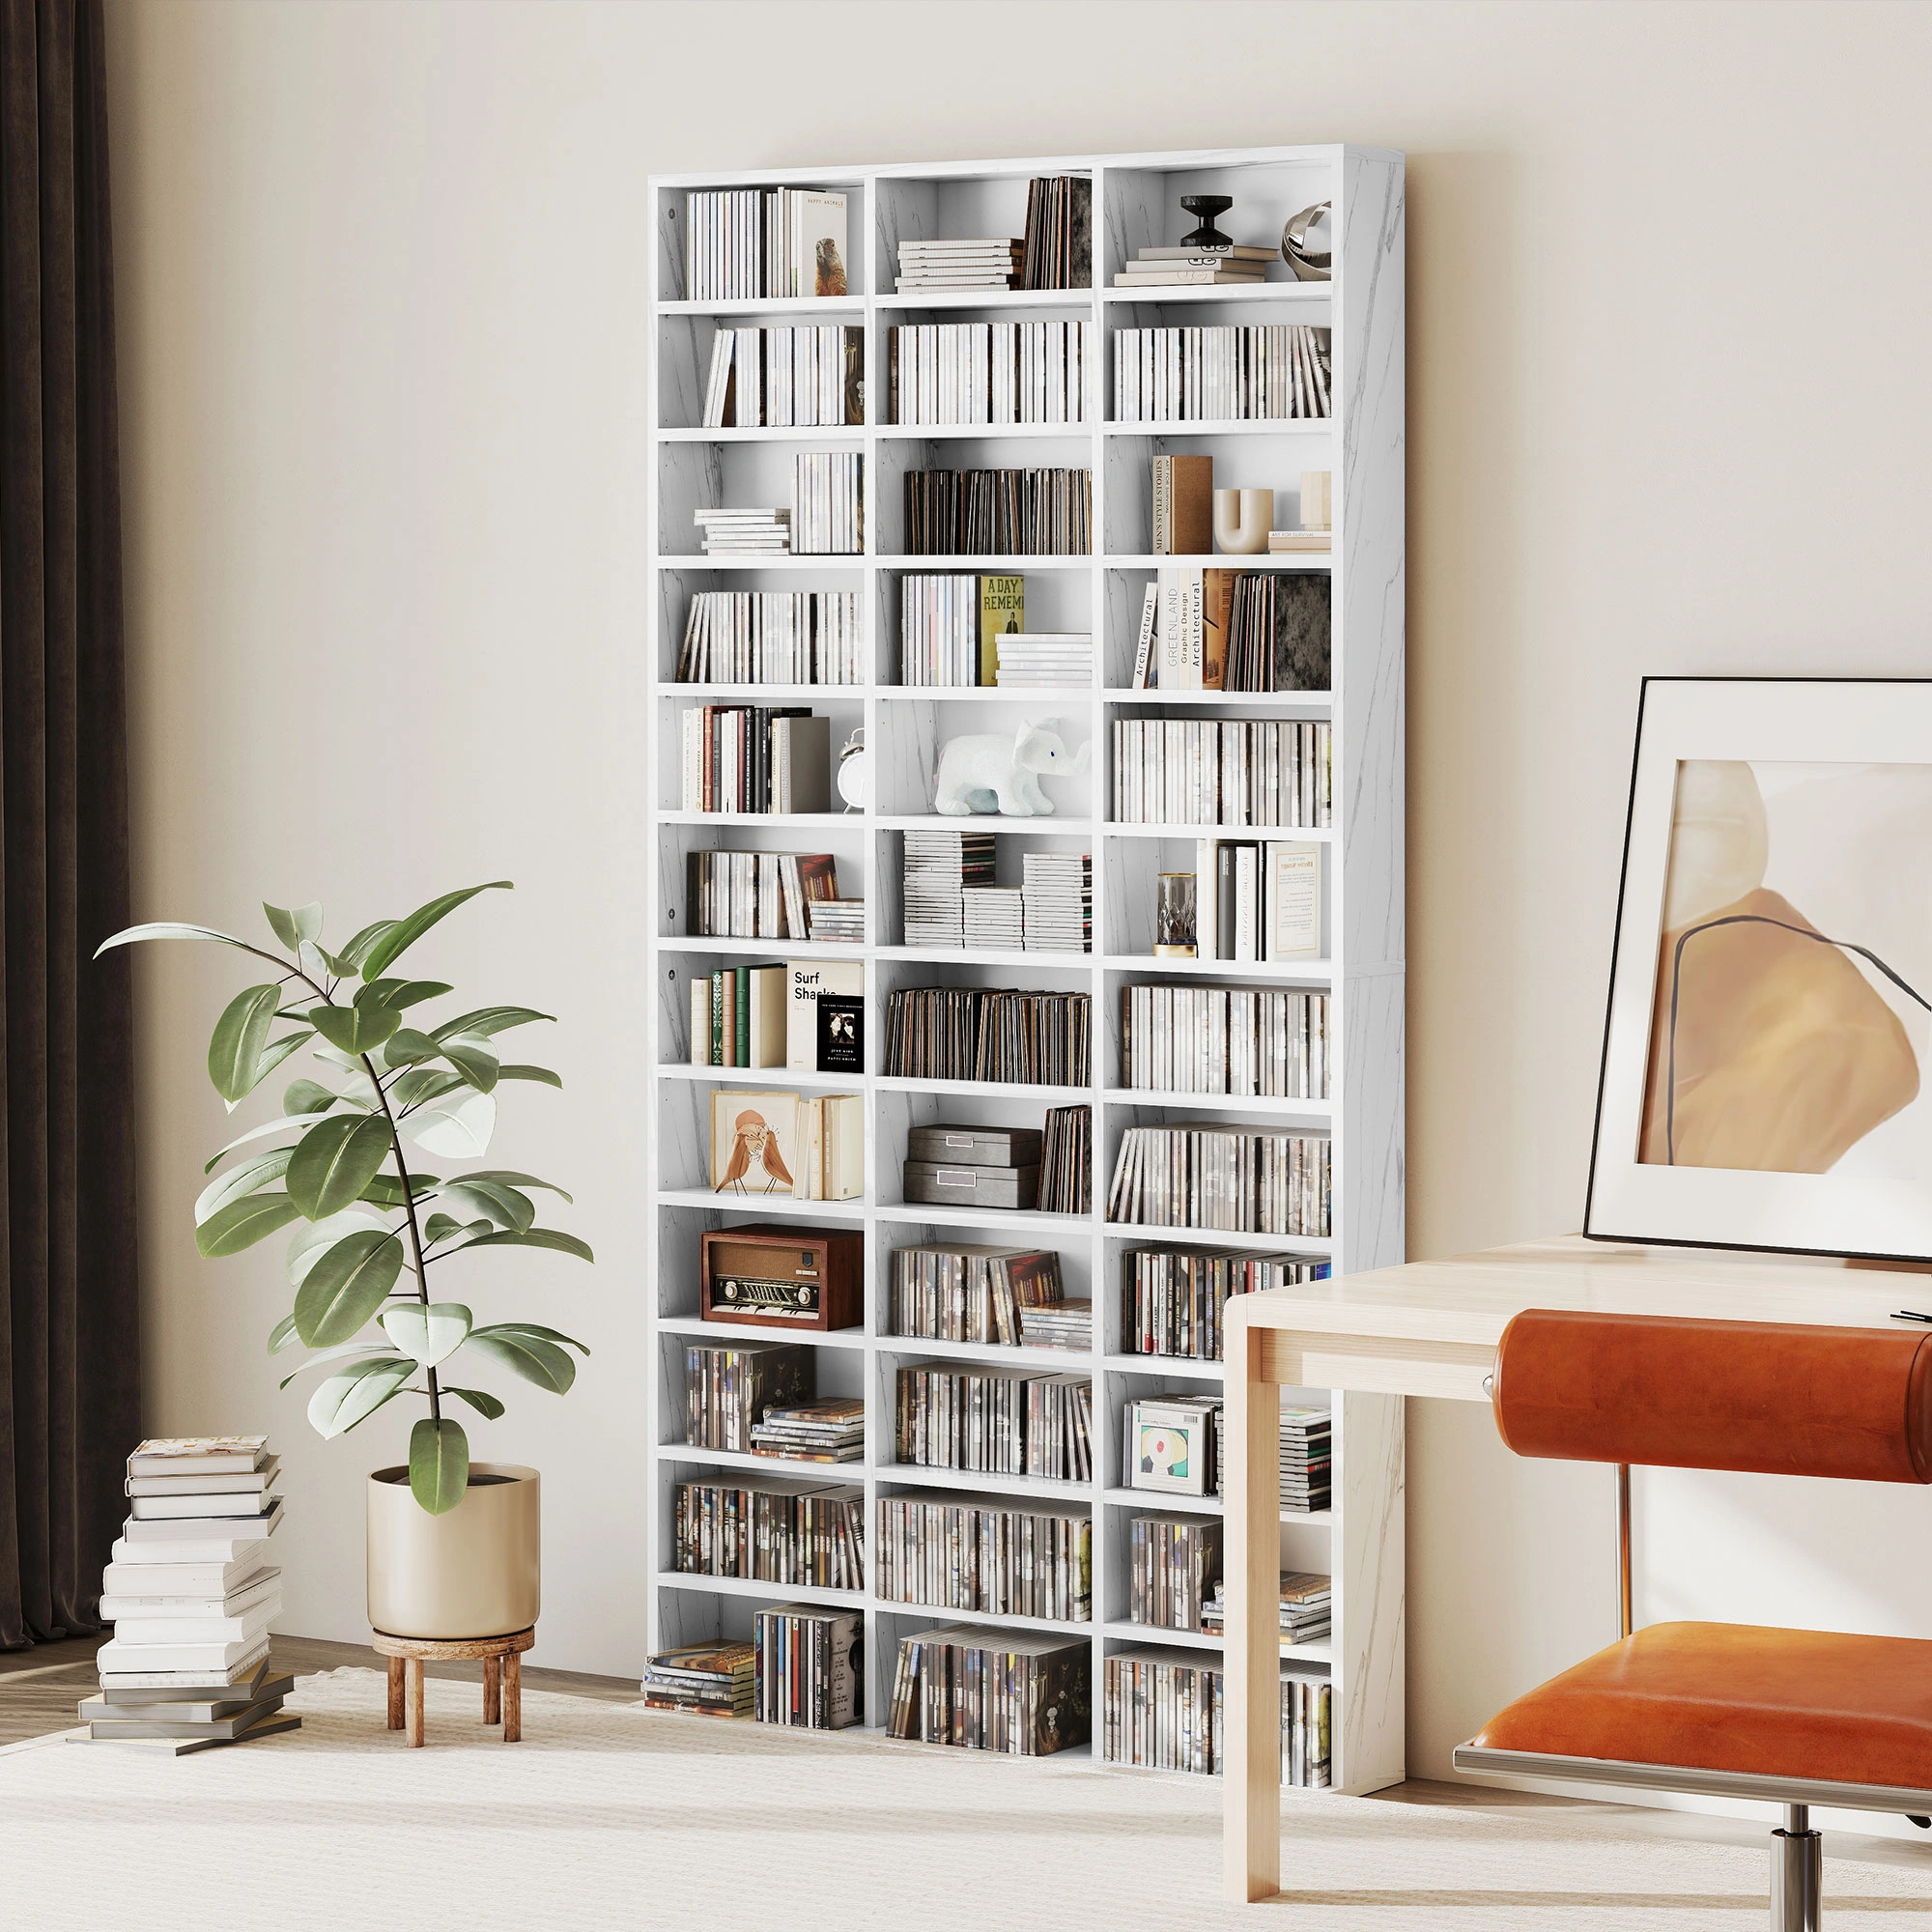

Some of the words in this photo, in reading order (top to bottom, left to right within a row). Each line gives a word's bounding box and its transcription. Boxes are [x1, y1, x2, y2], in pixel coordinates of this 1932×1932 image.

[988, 580, 995, 593] A
[997, 579, 1018, 593] DAY
[984, 596, 1024, 610] REMEM
[1169, 588, 1178, 667] GREENLAND
[1137, 599, 1152, 675] Architectural
[795, 972, 820, 984] Surf
